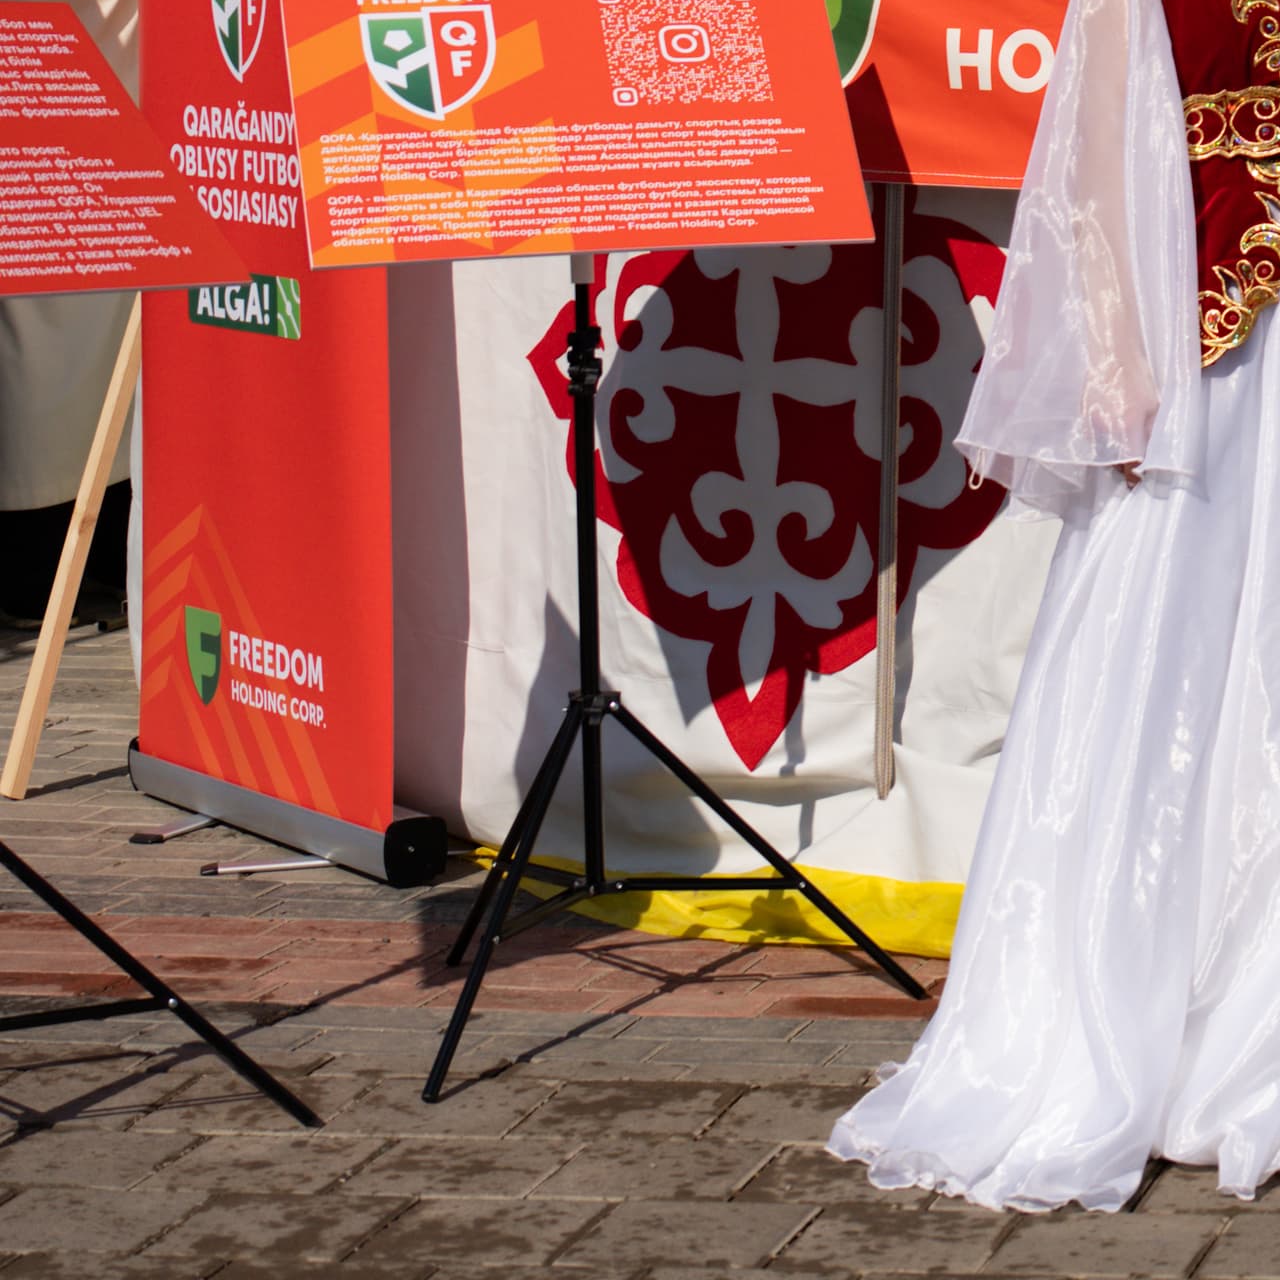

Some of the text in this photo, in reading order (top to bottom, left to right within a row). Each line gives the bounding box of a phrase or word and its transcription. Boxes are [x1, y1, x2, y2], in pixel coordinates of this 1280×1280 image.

[439, 18, 477, 49] Q
[451, 50, 473, 78] F
[183, 99, 296, 146] QARAĞANDY
[327, 195, 363, 205] QOFA
[372, 191, 451, 202] выстраивает
[465, 185, 563, 197] Карагандинской
[565, 183, 614, 192] области
[617, 180, 692, 191] футбольную
[765, 176, 811, 184] которая
[328, 206, 363, 216] будет
[367, 203, 426, 213] включать
[440, 199, 468, 208] себя
[471, 198, 522, 208] проекты
[525, 195, 580, 206] развития
[583, 192, 646, 201] массового
[705, 188, 756, 196] системы
[758, 186, 823, 194] подготовки
[330, 214, 408, 226] спортивного
[466, 208, 535, 217] подготовки
[538, 205, 580, 214] кадров
[583, 204, 606, 212] для
[608, 201, 671, 211] индустрии
[684, 199, 738, 208] развития
[740, 195, 809, 205] спортивной
[442, 220, 496, 230] Проекты
[498, 216, 576, 227] реализуются
[579, 215, 601, 223] при
[604, 211, 668, 221] поддержке
[671, 209, 718, 217] акимата
[720, 205, 814, 216] Карагандинской
[332, 237, 384, 246] области
[397, 231, 481, 242] генерального
[483, 228, 541, 237] спонсора
[544, 224, 615, 234] ассоциации
[627, 221, 678, 229] Freedom
[680, 219, 725, 228] Holding
[196, 282, 270, 326] ALGA!
[229, 630, 324, 693] FREEDOM
[231, 679, 327, 730] HOLDING CORP.
